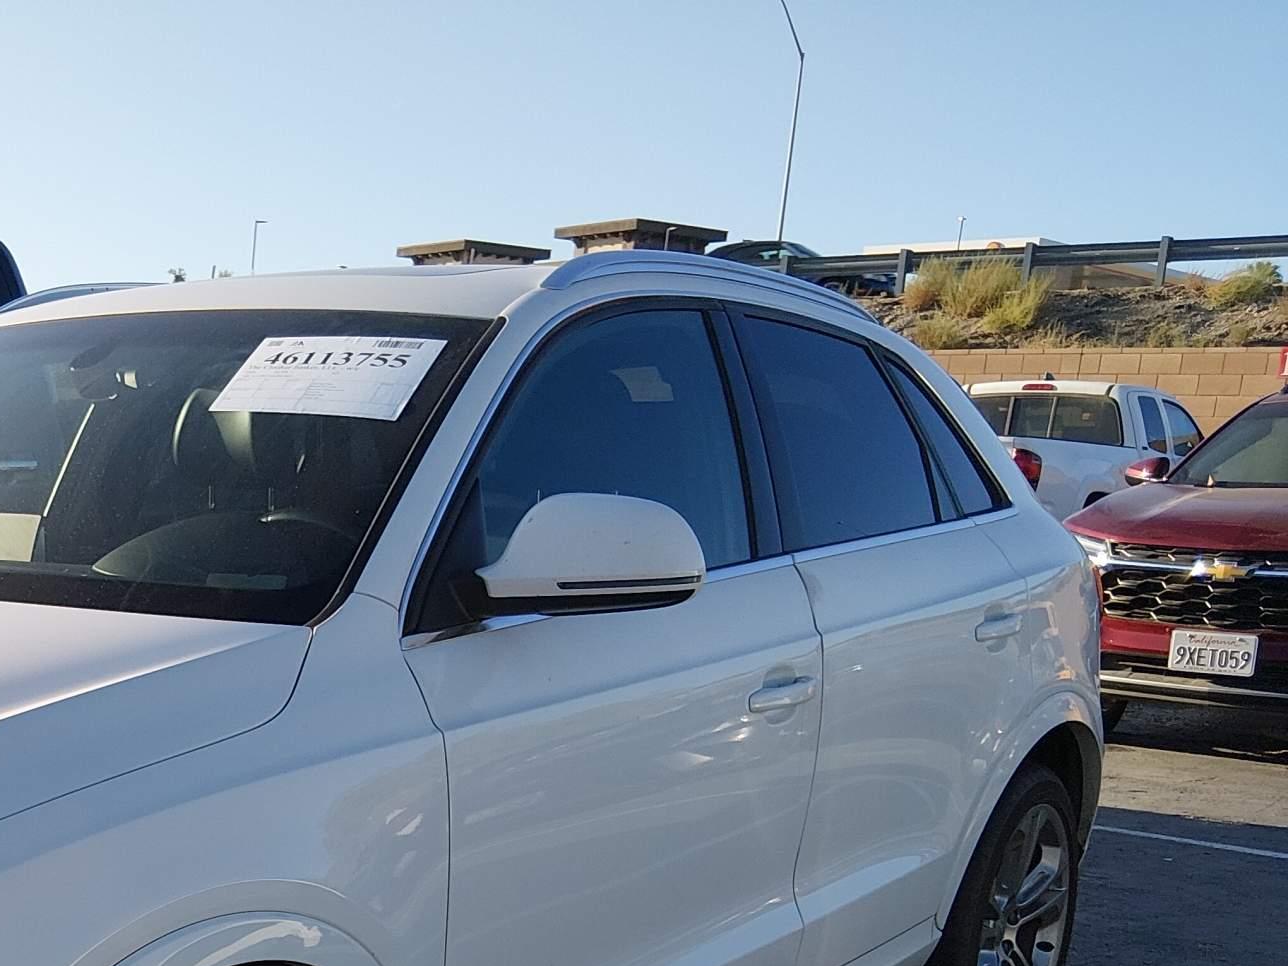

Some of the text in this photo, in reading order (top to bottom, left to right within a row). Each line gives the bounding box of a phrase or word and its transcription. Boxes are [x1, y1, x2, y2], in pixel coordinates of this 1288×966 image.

[263, 351, 413, 369] 46113755
[1189, 635, 1238, 647] California
[1174, 645, 1252, 671] 9XET059
